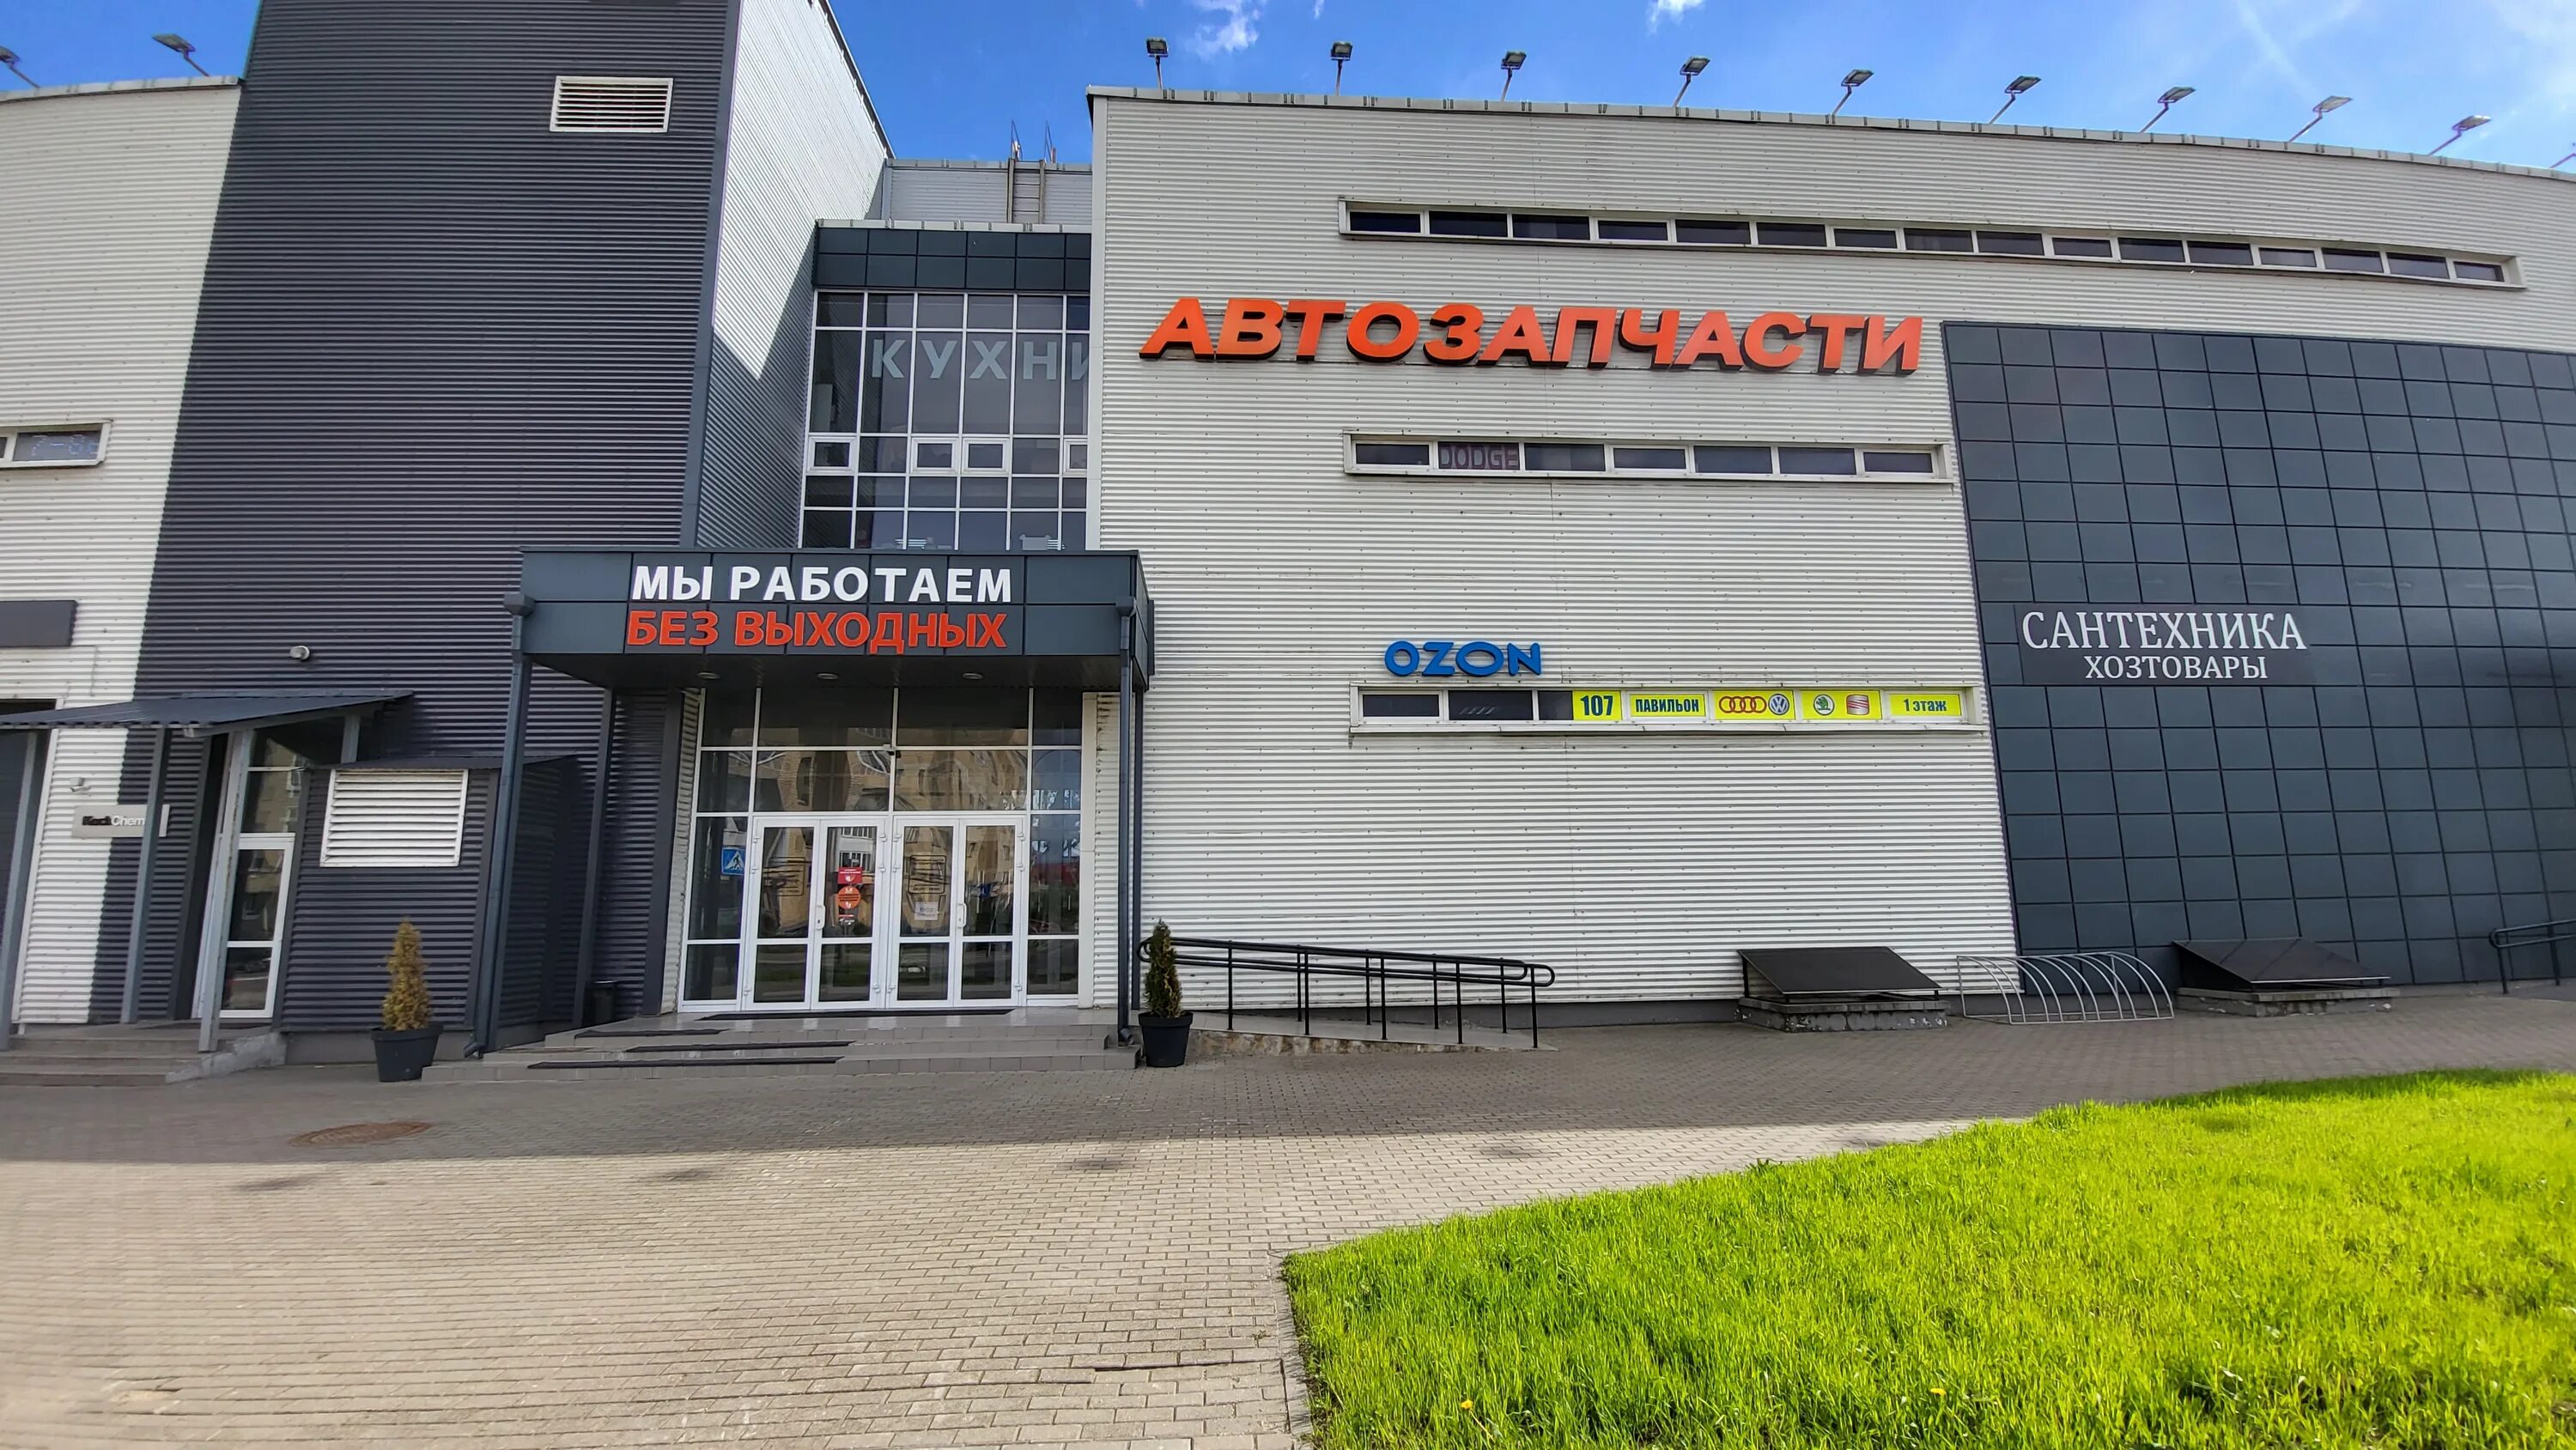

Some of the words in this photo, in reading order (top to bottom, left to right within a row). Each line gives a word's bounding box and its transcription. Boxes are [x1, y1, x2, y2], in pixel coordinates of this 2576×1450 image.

[1139, 297, 1923, 375] АВТОЗАПЧАСТИ
[1438, 444, 1520, 469] DODGE
[631, 565, 714, 601] МЫ
[729, 566, 1012, 604] РАБОТАЕМ
[627, 610, 719, 646] БЕЗ
[734, 610, 1008, 655] ВЫХОДНЫХ
[2021, 610, 2308, 651] САНТЕХНИКА
[1384, 640, 1542, 677] OZON
[2083, 655, 2269, 680] ХОЗТОВАРЫ
[1580, 695, 1614, 716] 107
[1635, 698, 1699, 713] ПАВИЛЬОН
[1912, 700, 1947, 712] этаж
